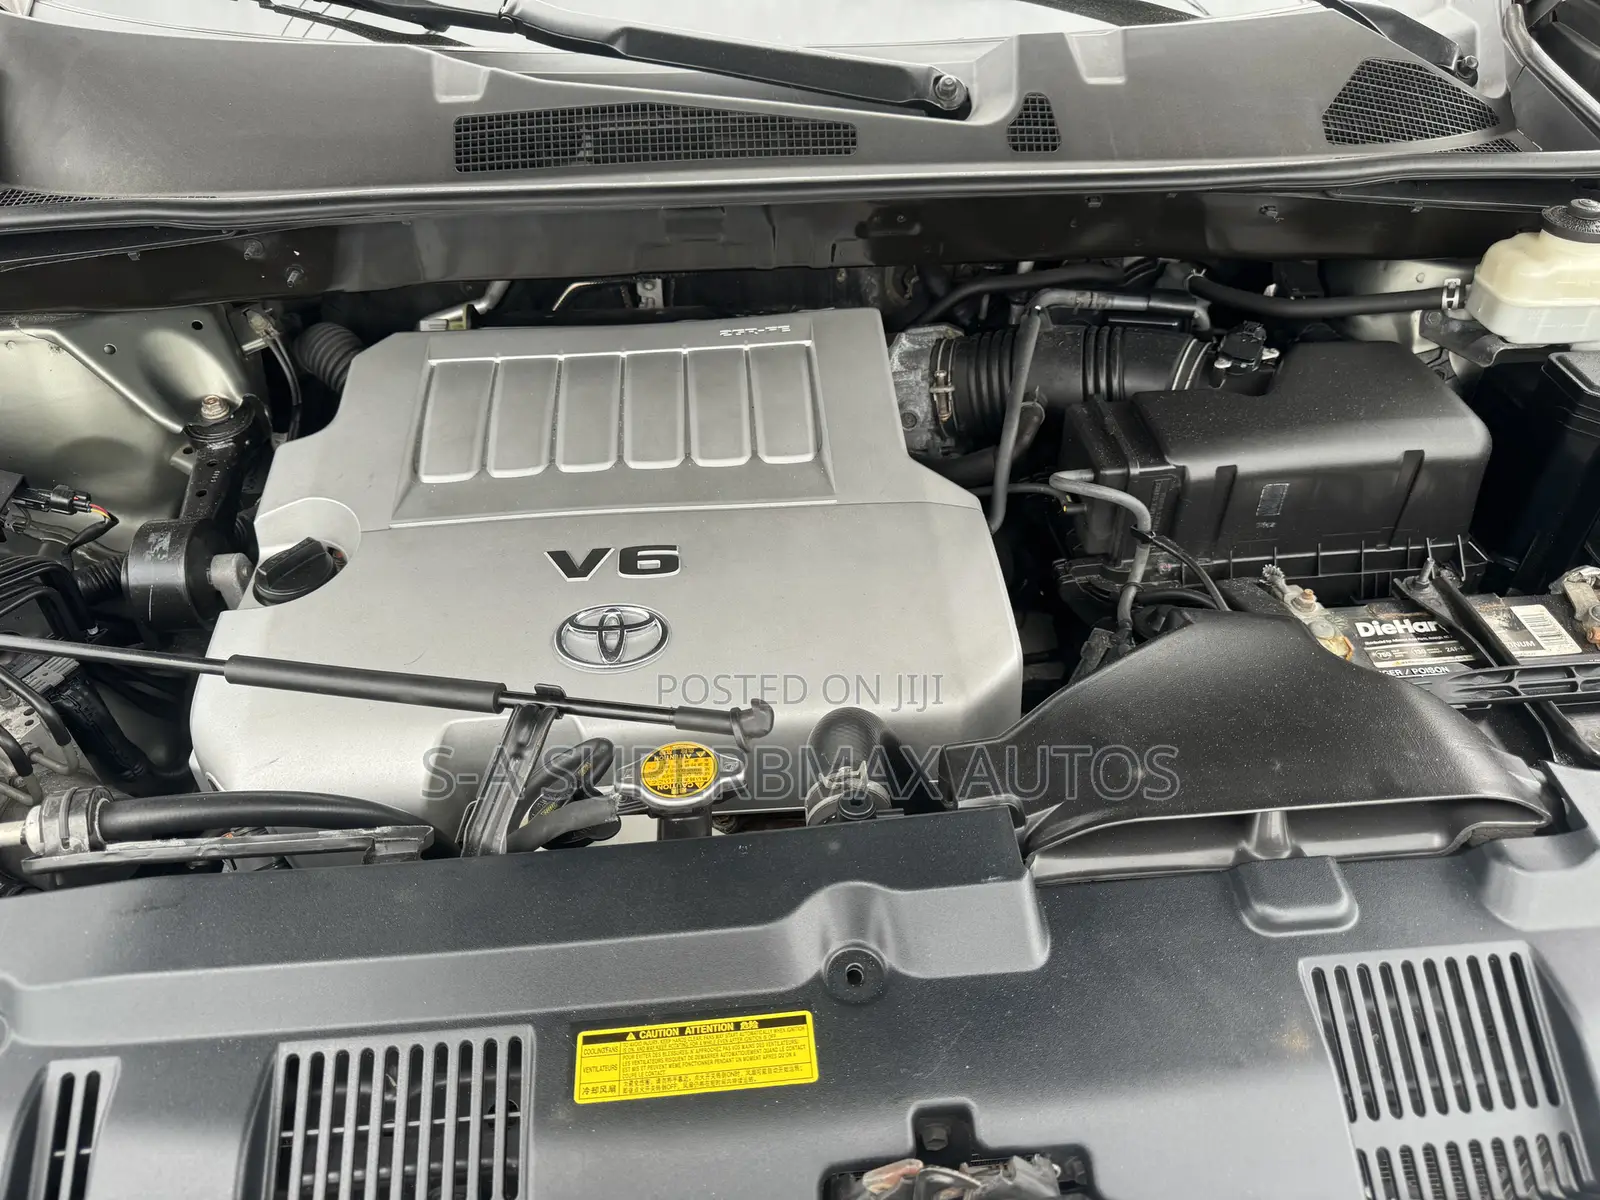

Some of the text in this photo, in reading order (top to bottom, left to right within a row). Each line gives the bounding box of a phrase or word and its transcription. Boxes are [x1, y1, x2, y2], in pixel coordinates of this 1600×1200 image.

[544, 544, 681, 582] V6
[1355, 619, 1440, 638] DieHar
[1412, 666, 1450, 675] POISON
[639, 1022, 734, 1039] CAUTION ATTENTION
